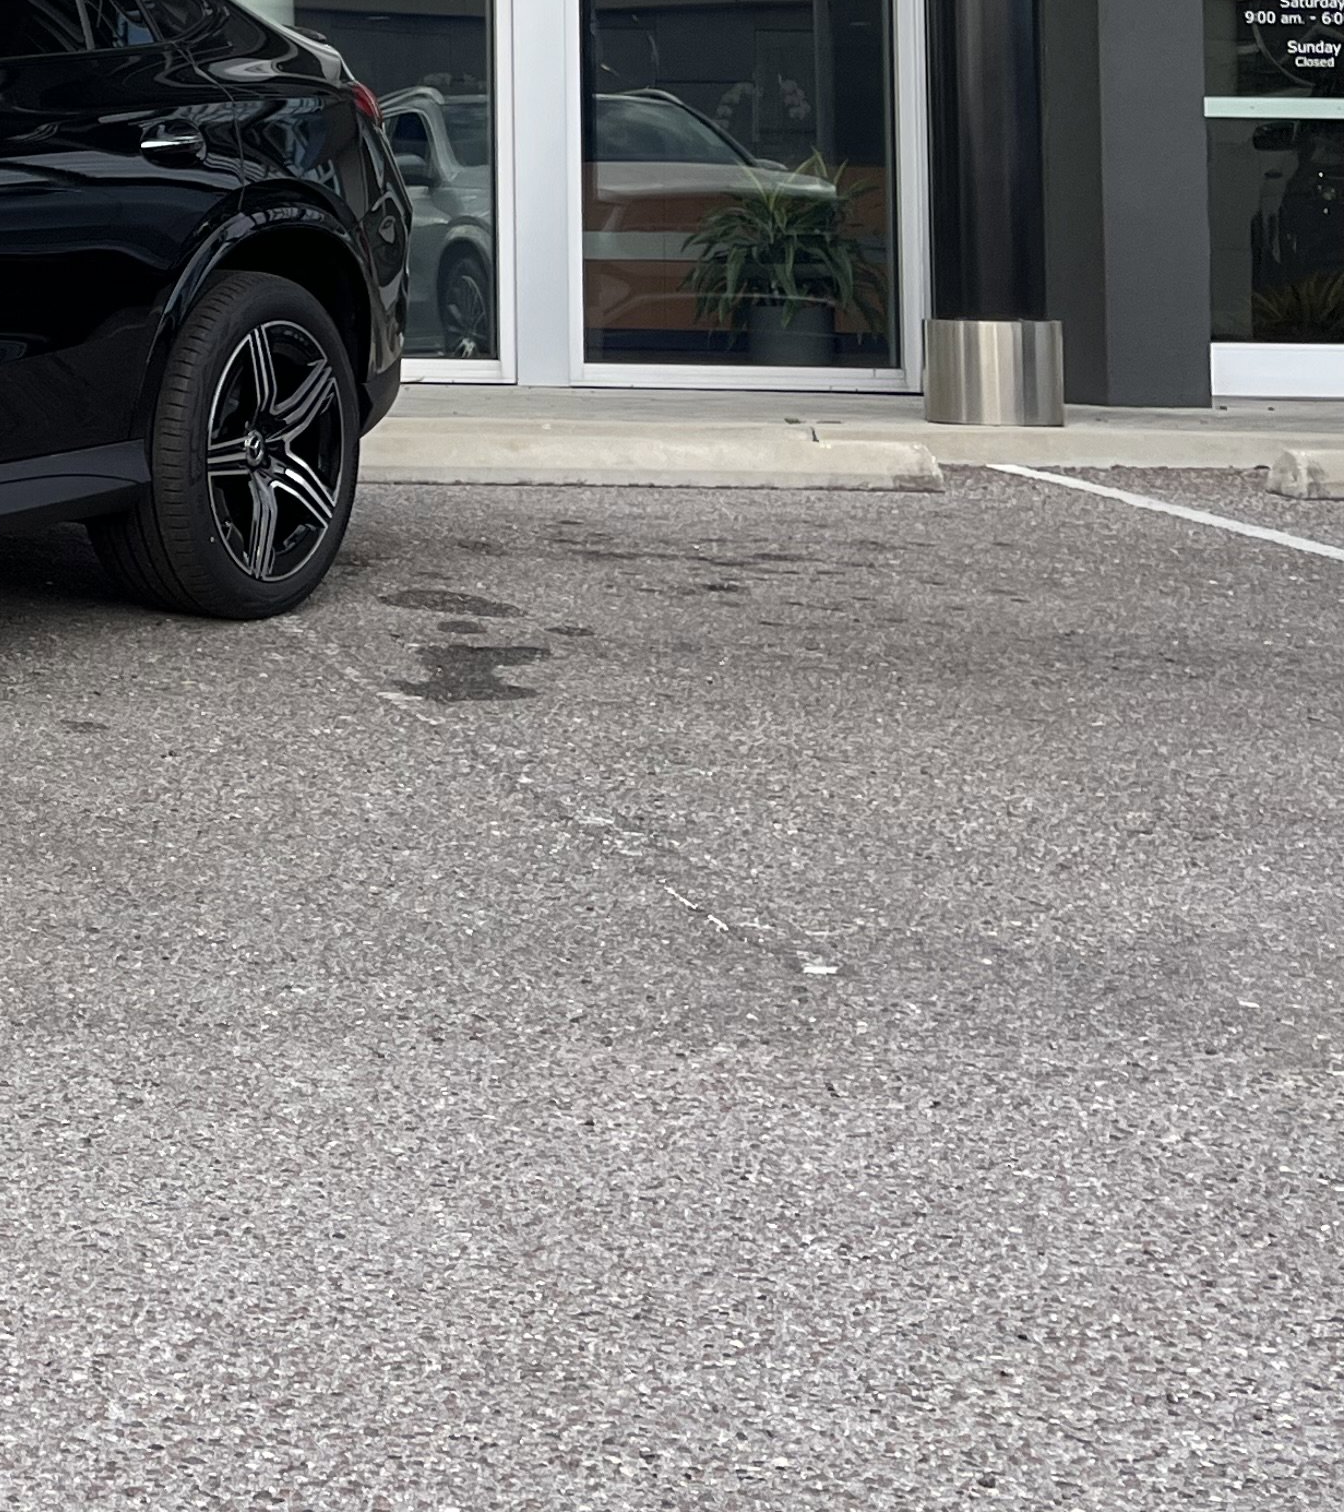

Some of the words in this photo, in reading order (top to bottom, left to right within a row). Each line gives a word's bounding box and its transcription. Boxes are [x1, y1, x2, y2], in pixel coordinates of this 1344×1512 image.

[1244, 10, 1276, 24] 9:00
[1287, 39, 1342, 56] Sunday
[1294, 56, 1335, 68] Closed
